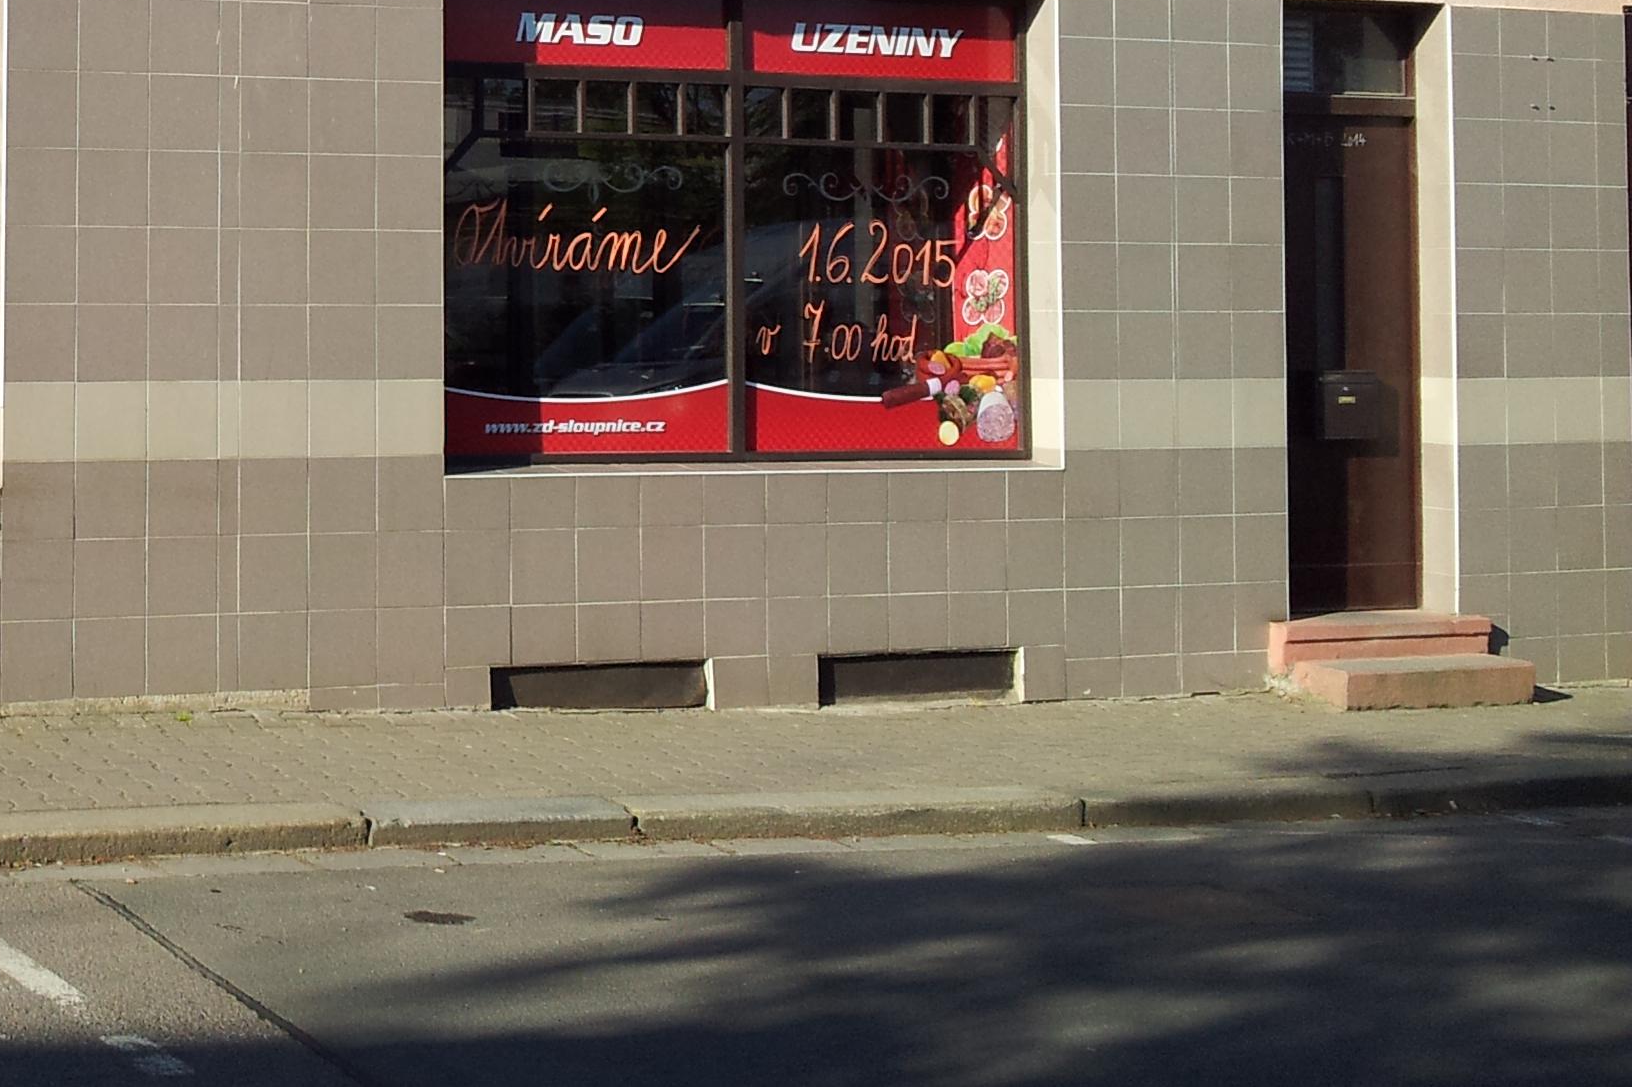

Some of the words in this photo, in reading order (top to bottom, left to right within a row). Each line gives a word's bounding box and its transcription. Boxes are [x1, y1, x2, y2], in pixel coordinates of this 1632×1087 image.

[515, 12, 644, 47] MASO
[791, 22, 963, 58] UZENINY
[756, 324, 781, 355] v
[802, 300, 863, 363] 7.00
[871, 313, 917, 363] hod
[485, 419, 666, 436] www.zd-sloupnice.cz
